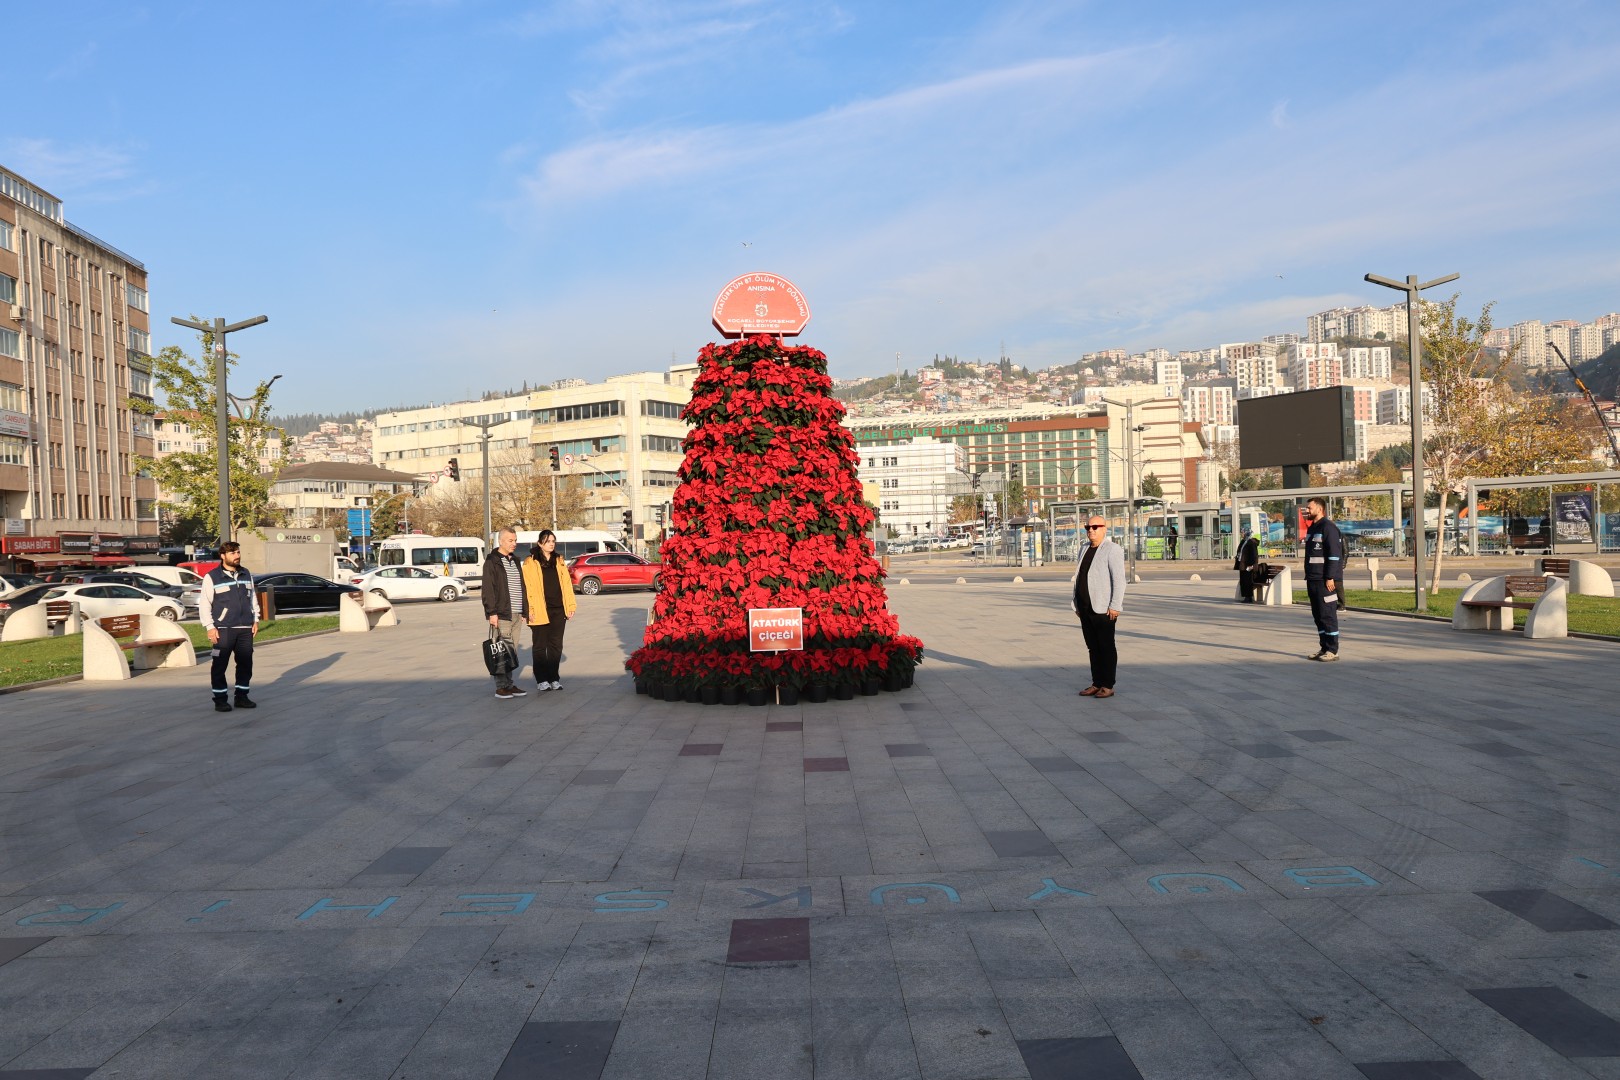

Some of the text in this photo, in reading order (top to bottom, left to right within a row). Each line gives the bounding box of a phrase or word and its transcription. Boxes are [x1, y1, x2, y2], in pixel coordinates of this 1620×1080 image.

[717, 281, 744, 314] ATATÜRK'ÜN
[755, 275, 775, 284] ÖLÜM
[777, 280, 786, 289] YIL
[786, 288, 806, 317] DÖNÜMÜ
[892, 427, 937, 439] DEVLET
[942, 423, 1008, 435] HASTANESİ
[14, 539, 51, 550] SABAH BÜFE
[752, 618, 800, 628] ATATÜRK
[758, 630, 794, 642] ÇİÇEĞİ
